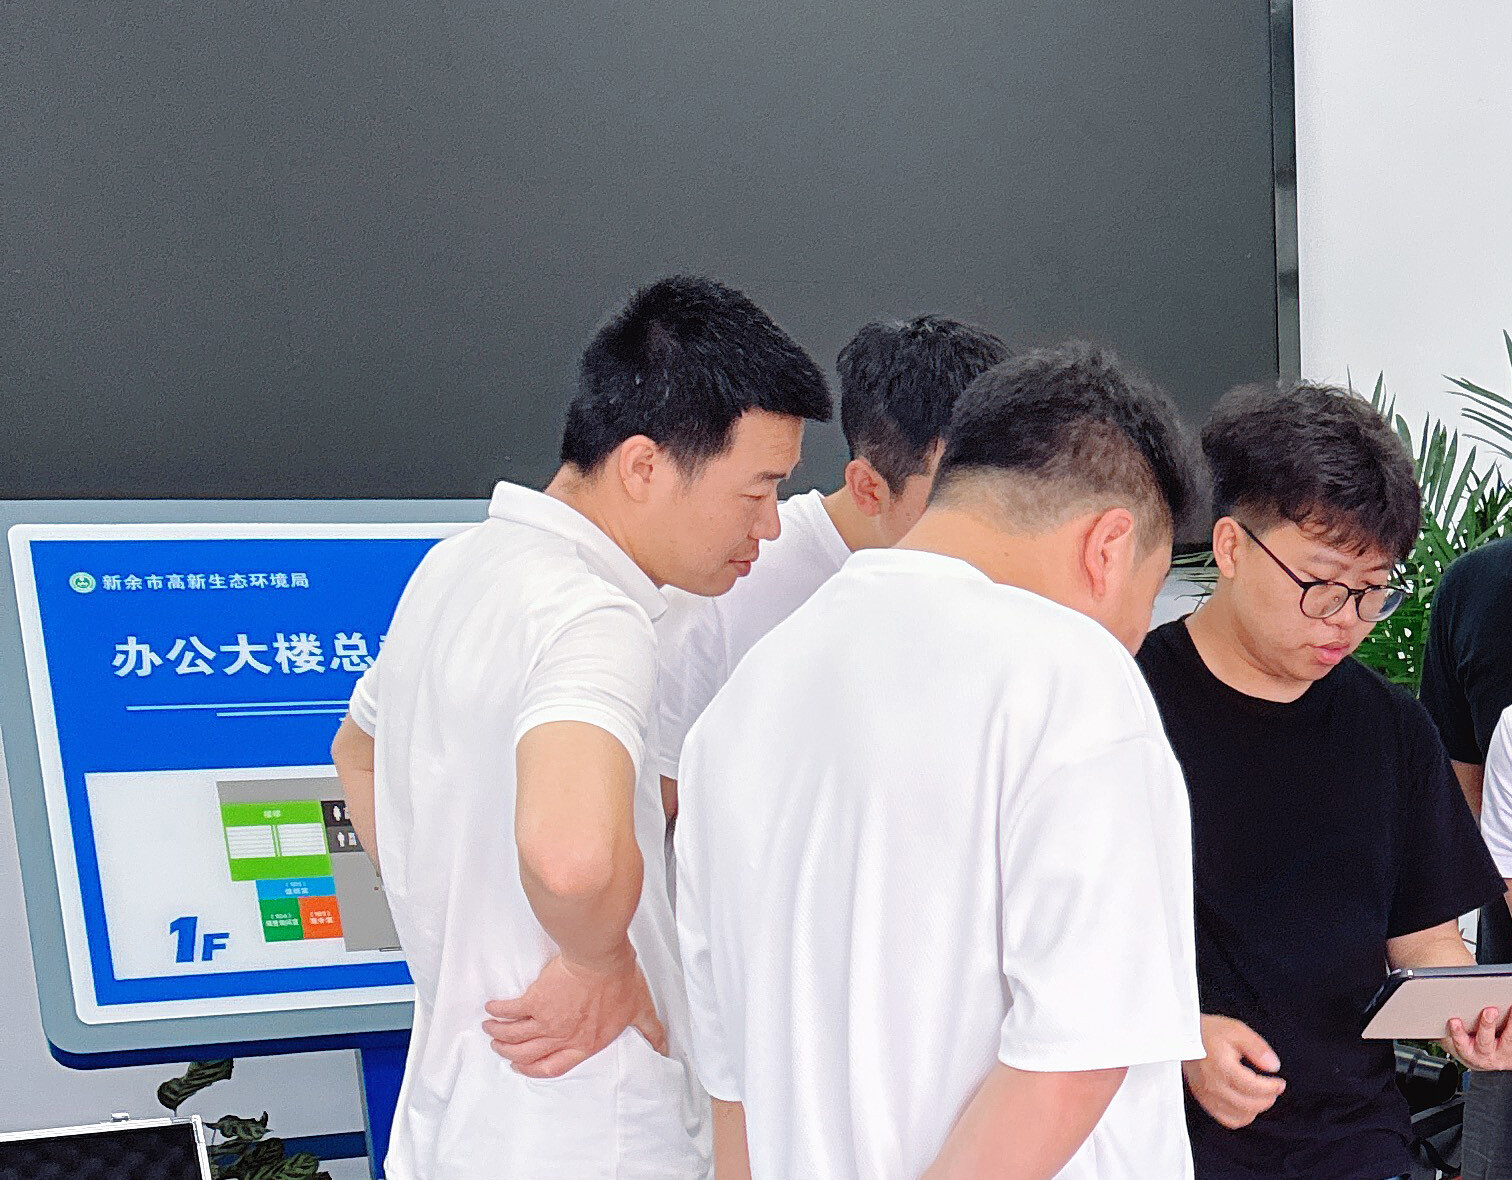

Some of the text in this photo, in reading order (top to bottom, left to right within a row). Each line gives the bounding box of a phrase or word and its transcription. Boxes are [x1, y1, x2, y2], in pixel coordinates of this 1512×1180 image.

[101, 572, 310, 592] 新余市高新生态环境局
[111, 632, 388, 677] 办公大楼总
[169, 915, 230, 963] 1F
